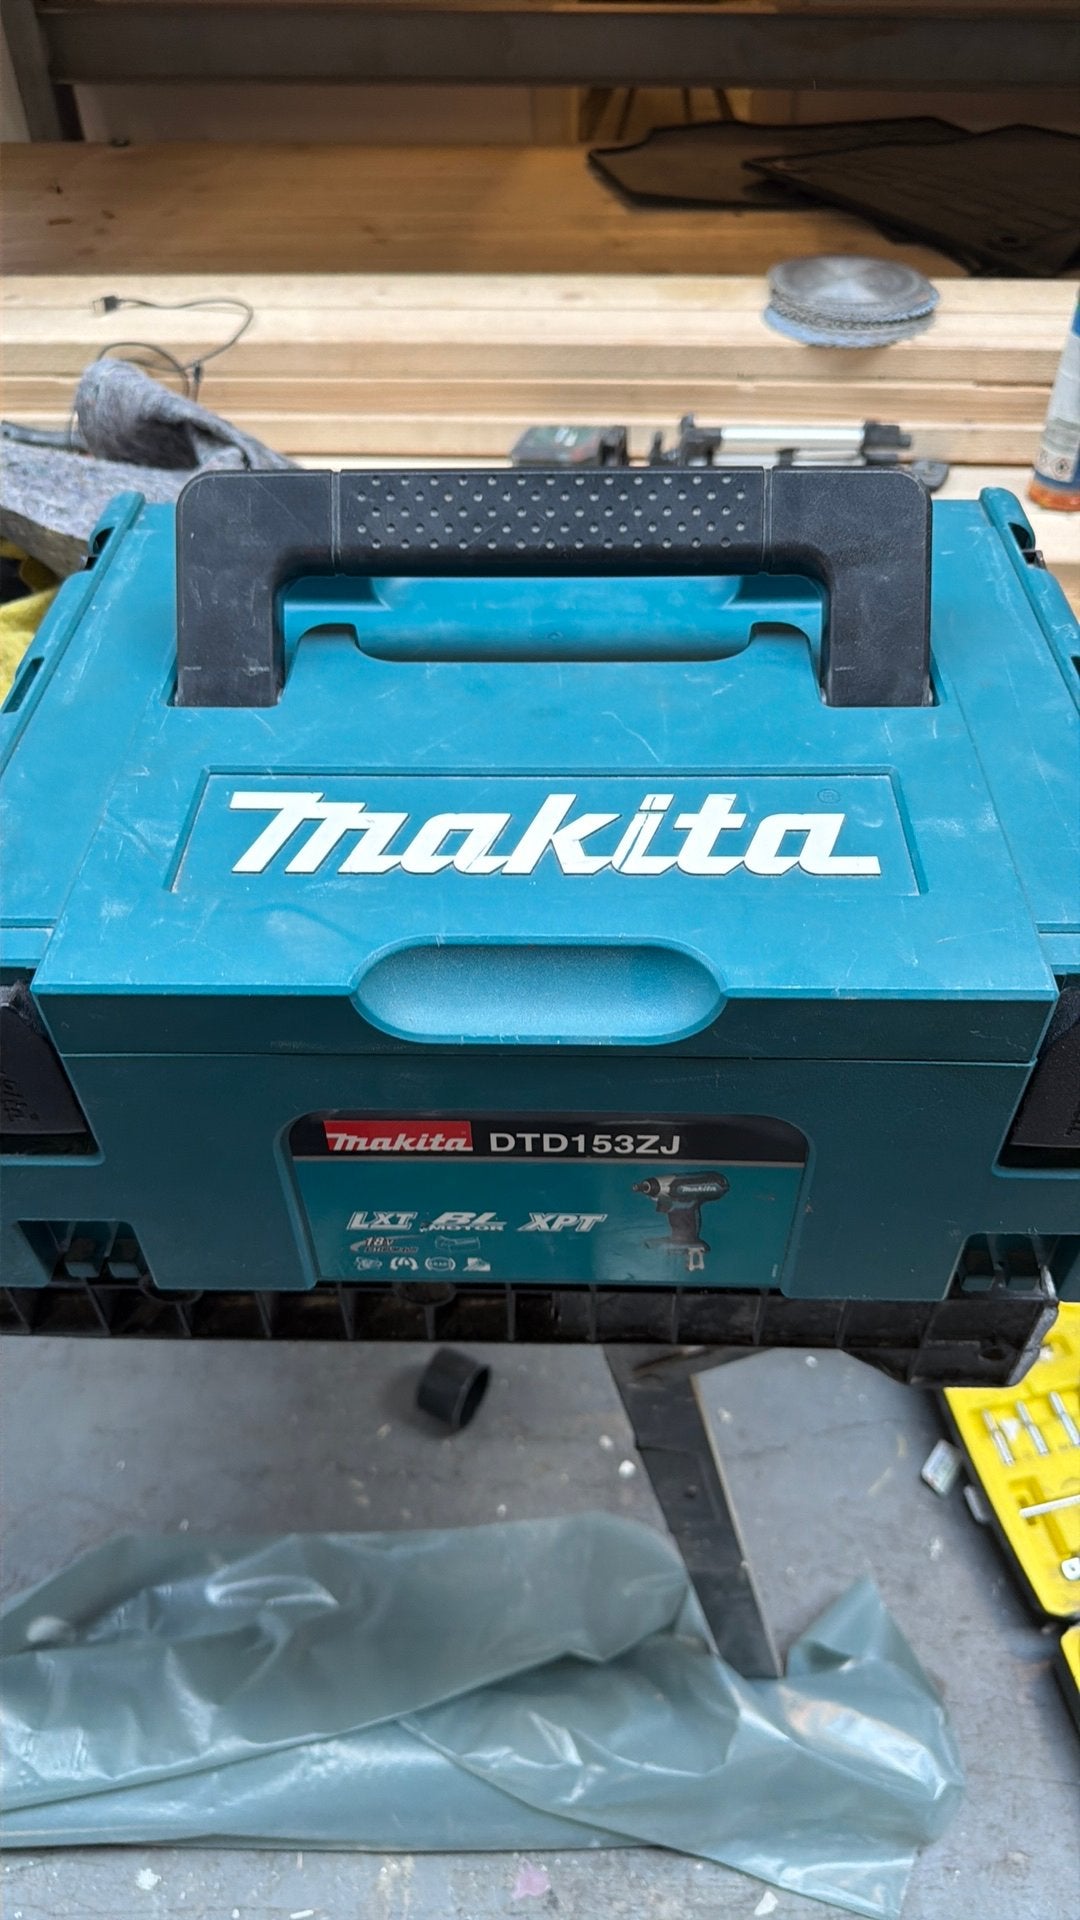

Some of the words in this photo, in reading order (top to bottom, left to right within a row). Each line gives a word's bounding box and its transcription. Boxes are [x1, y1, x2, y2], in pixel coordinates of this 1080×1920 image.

[490, 1132, 681, 1155] DTD153ZJ
[347, 1212, 418, 1231] LXT
[428, 1223, 505, 1232] MOTOR
[517, 1212, 608, 1232] XPT
